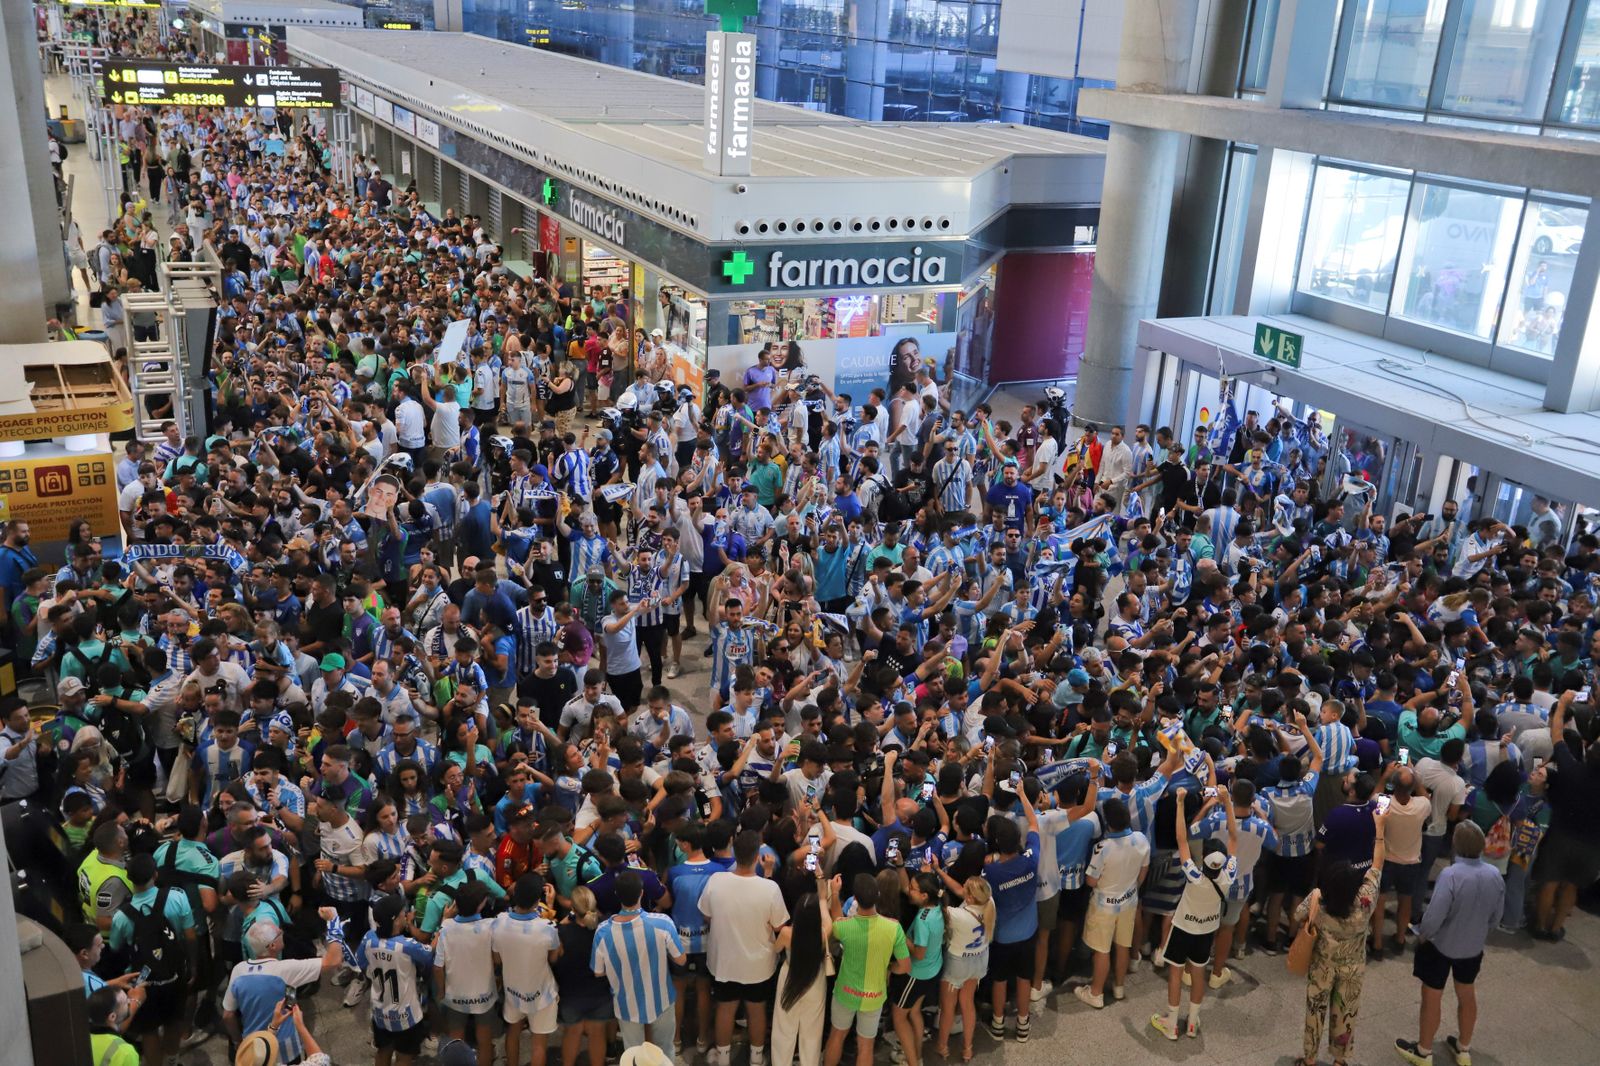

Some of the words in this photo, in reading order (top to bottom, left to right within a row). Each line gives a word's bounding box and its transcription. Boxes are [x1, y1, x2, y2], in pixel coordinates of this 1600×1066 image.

[172, 93, 197, 104] 363
[201, 93, 226, 106] 386
[707, 39, 720, 155] farmacia
[727, 40, 752, 158] farmacia
[569, 189, 624, 246] farmacia
[768, 246, 947, 288] farmacia
[840, 354, 898, 369] CAUDALIE
[36, 411, 108, 426] PROTECTION
[57, 421, 109, 433] EQUIPAJES
[9, 502, 49, 511] LUGGAGE
[50, 497, 103, 507] PROTECTION
[966, 923, 985, 949] 2
[372, 967, 400, 1004] 11
